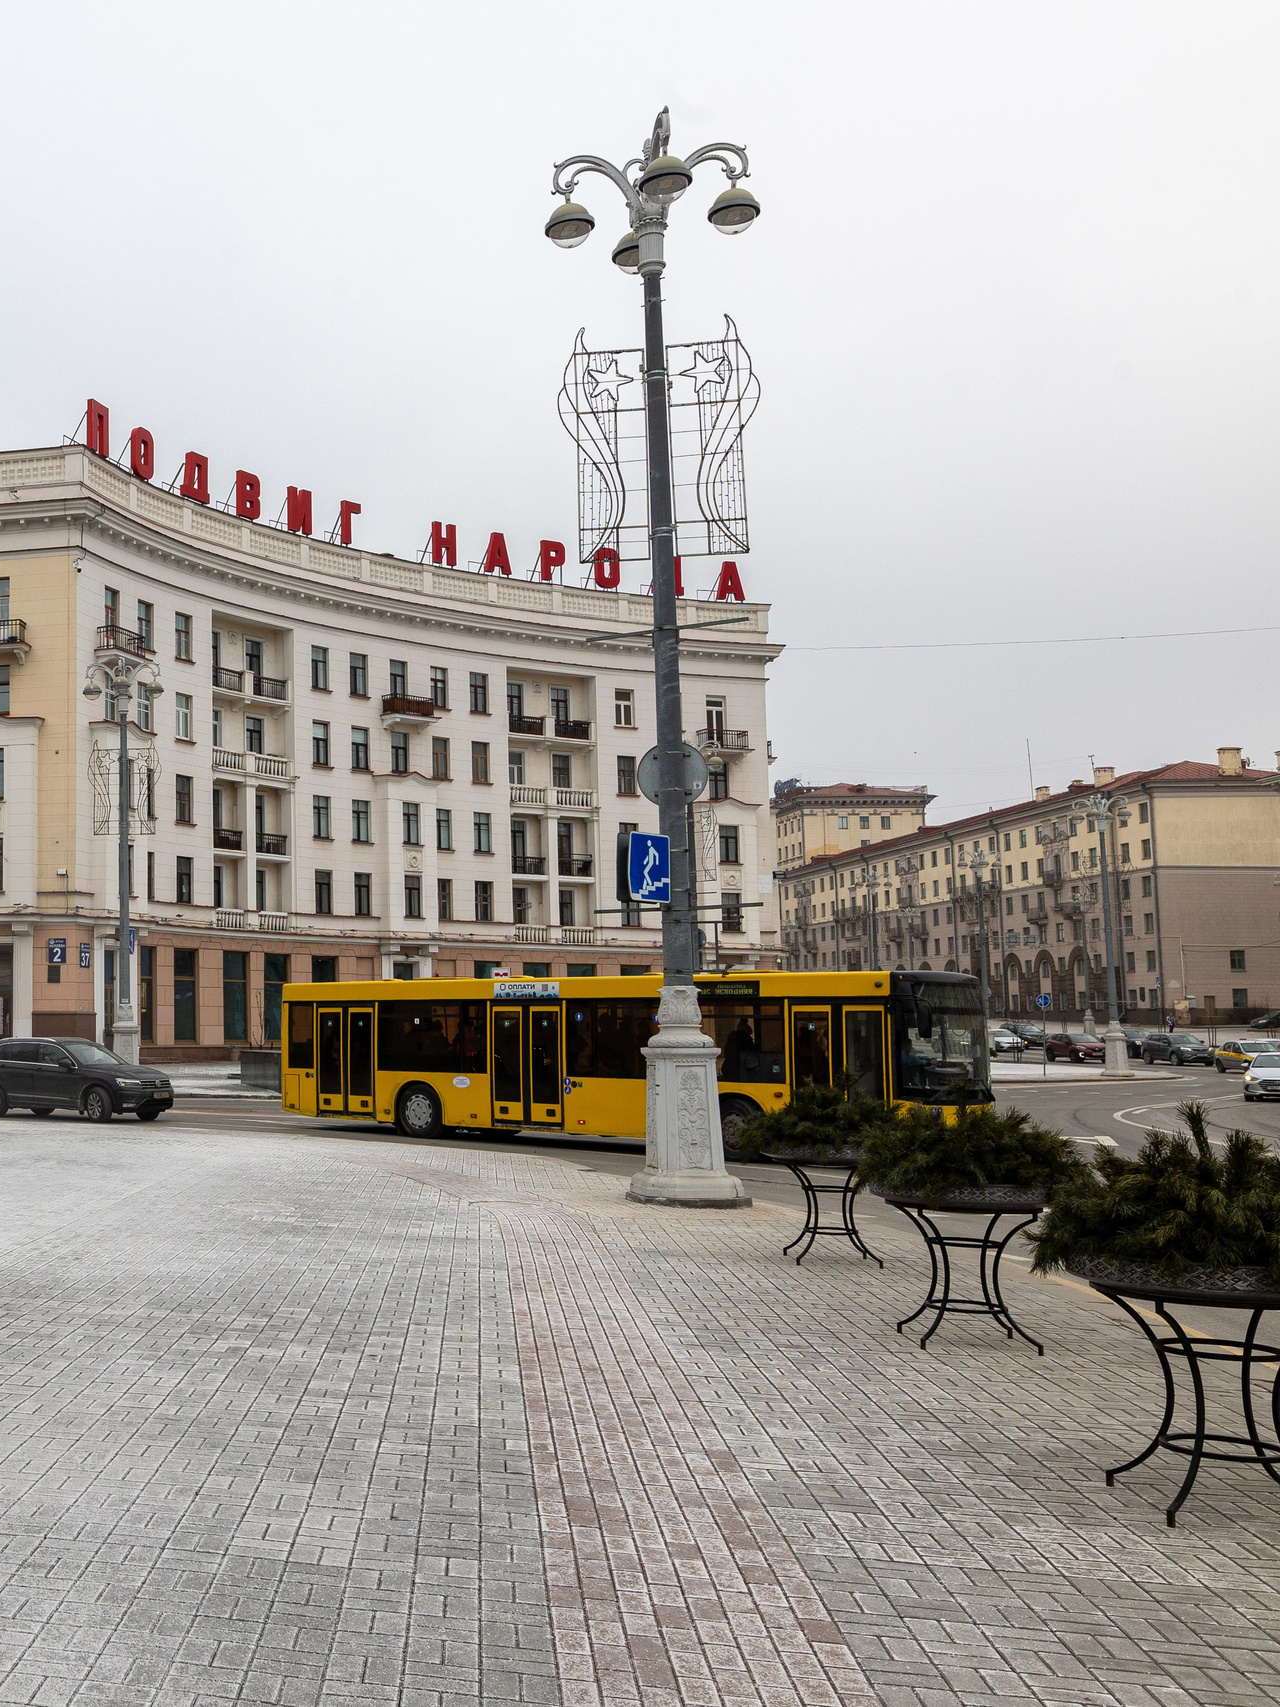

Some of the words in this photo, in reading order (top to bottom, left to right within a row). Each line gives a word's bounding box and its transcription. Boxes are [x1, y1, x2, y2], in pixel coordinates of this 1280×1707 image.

[86, 398, 362, 546] ПОДВИГ
[53, 948, 61, 962] 2
[81, 953, 90, 966] 37
